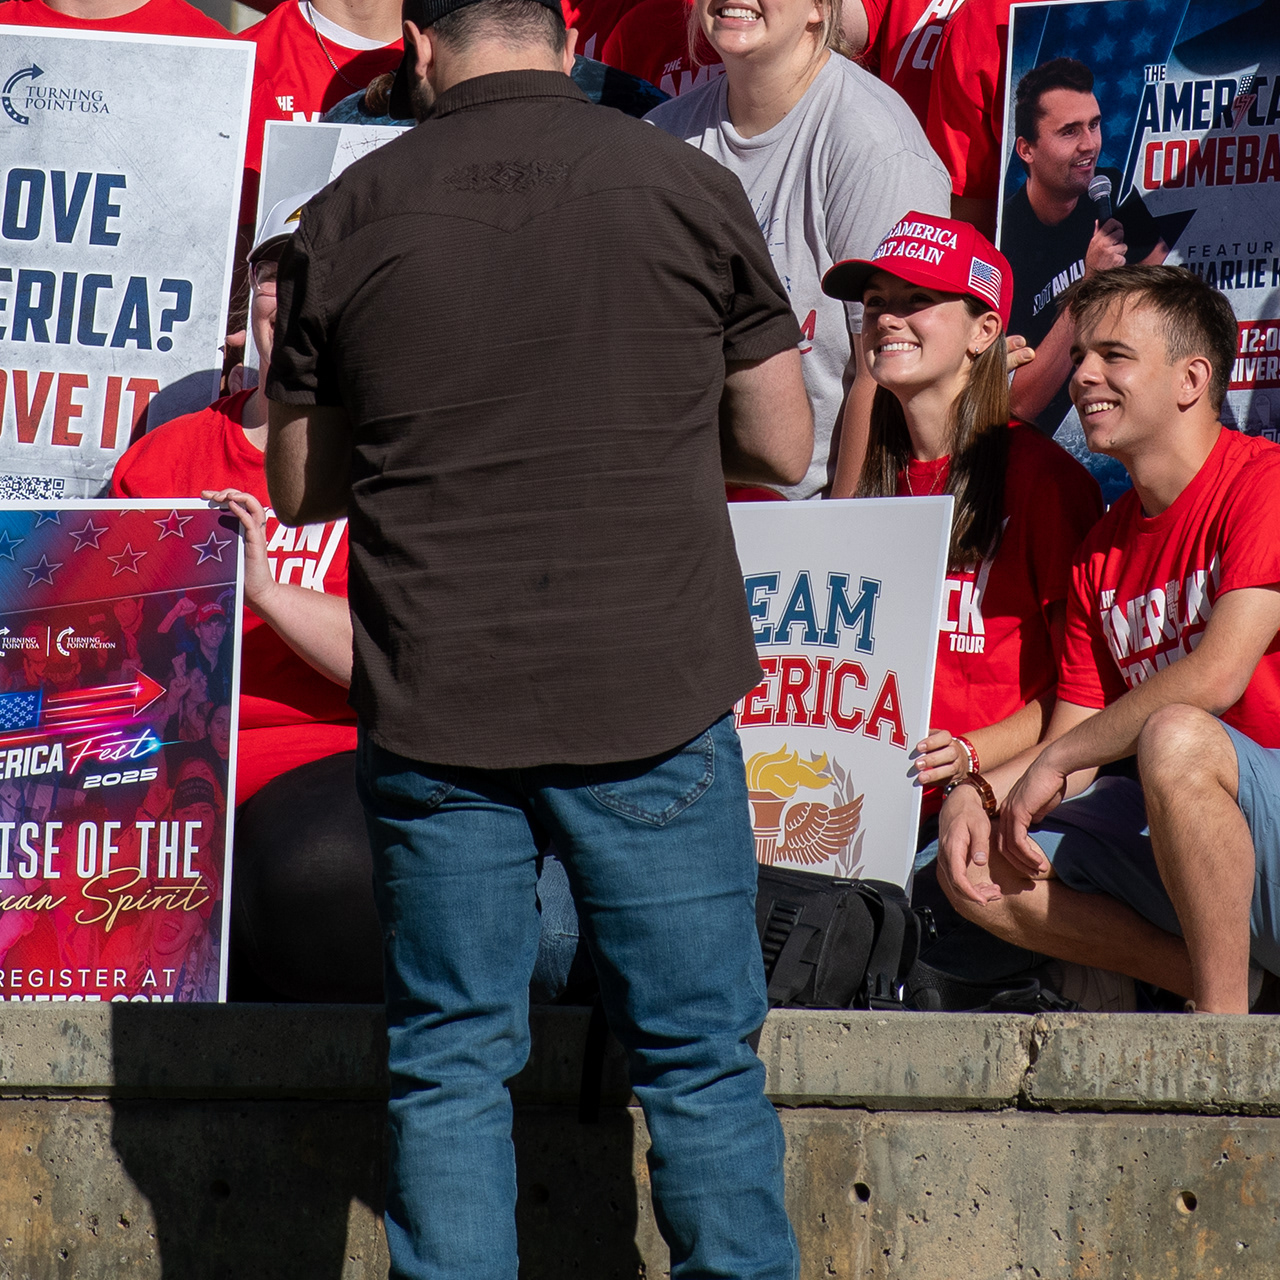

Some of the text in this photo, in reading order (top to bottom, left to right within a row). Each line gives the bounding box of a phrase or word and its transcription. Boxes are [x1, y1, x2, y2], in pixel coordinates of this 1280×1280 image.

[1144, 64, 1167, 83] THE
[25, 85, 104, 103] TURNING
[25, 96, 110, 115] POINT USA
[894, 221, 958, 250] AMERICA
[893, 240, 945, 266] AGAIN
[1052, 269, 1070, 297] AN
[99, 376, 161, 450] IT
[743, 569, 883, 655] EAM
[949, 633, 986, 655] TOUR
[734, 655, 909, 751] ERICA
[66, 728, 160, 775] Fest
[82, 767, 159, 790] 2025
[77, 821, 121, 879] OF
[135, 820, 203, 878] THE
[75, 866, 210, 933] Spirit
[141, 968, 176, 987] AT
